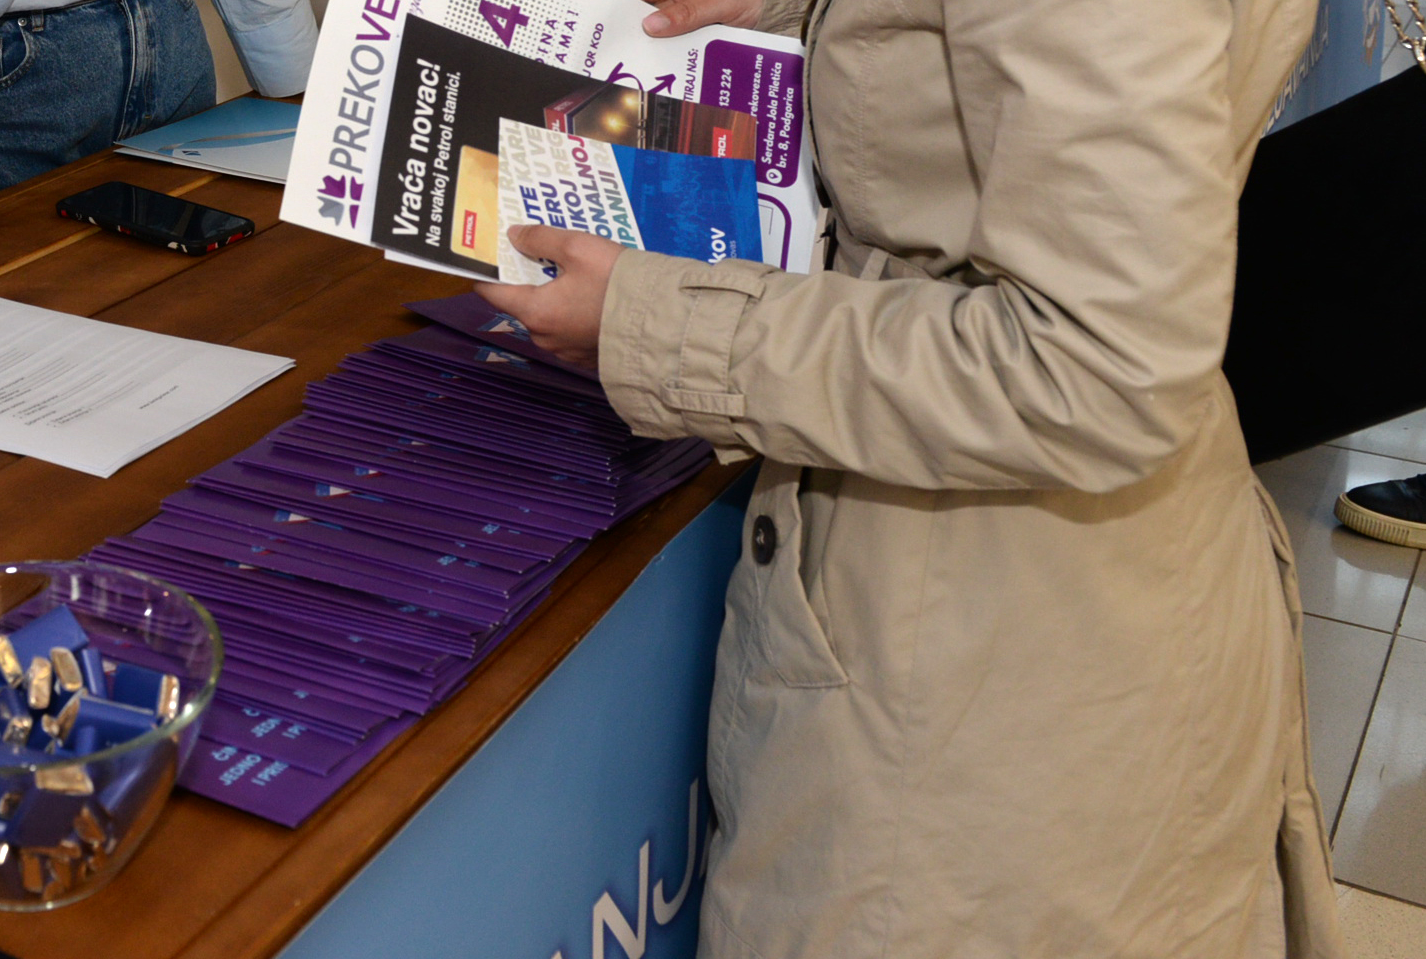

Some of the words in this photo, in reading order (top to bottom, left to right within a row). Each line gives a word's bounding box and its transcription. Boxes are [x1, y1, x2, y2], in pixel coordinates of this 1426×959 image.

[590, 22, 604, 50] KOD
[584, 50, 597, 68] QR
[686, 49, 699, 73] NAS:
[721, 68, 732, 89] 224
[748, 54, 763, 124] rekoveze.me
[768, 62, 782, 99] Piletića
[441, 71, 461, 123] stanici.
[719, 89, 730, 107] 133
[767, 100, 778, 120] Jola
[779, 87, 795, 138] Podgorica
[392, 158, 426, 235] Vraća
[409, 58, 441, 153] novac!
[434, 124, 454, 171] Petrol
[761, 121, 776, 164] Serdara
[778, 141, 790, 151] 8,
[776, 153, 787, 168] br.
[430, 172, 450, 222] svakoj
[559, 178, 590, 233] IKOJ
[598, 170, 638, 250] PANIJI
[425, 222, 441, 247] Na
[464, 214, 474, 246] PETROL
